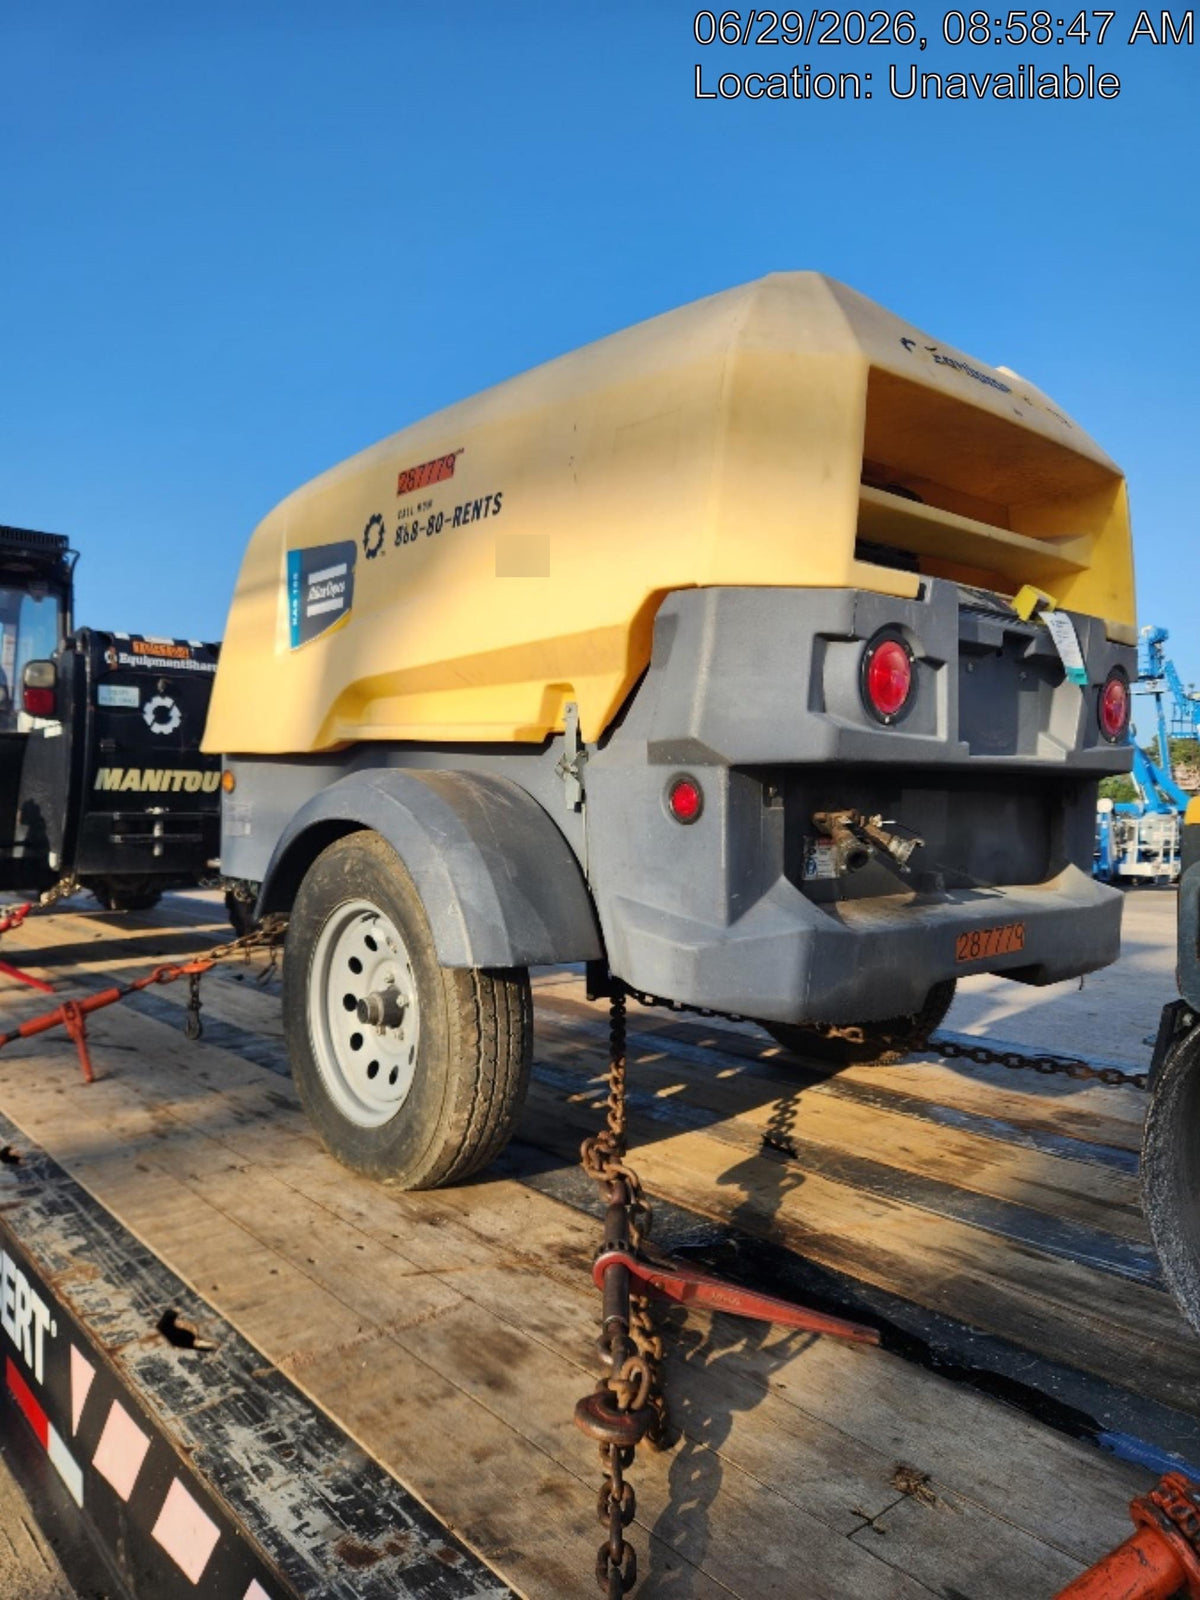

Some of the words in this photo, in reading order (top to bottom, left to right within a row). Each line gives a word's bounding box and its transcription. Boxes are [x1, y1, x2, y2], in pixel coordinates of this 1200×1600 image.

[397, 453, 456, 496] 287779
[94, 767, 221, 793] MANITOU
[958, 923, 1024, 961] 287779
[0, 1248, 51, 1386] ERT
